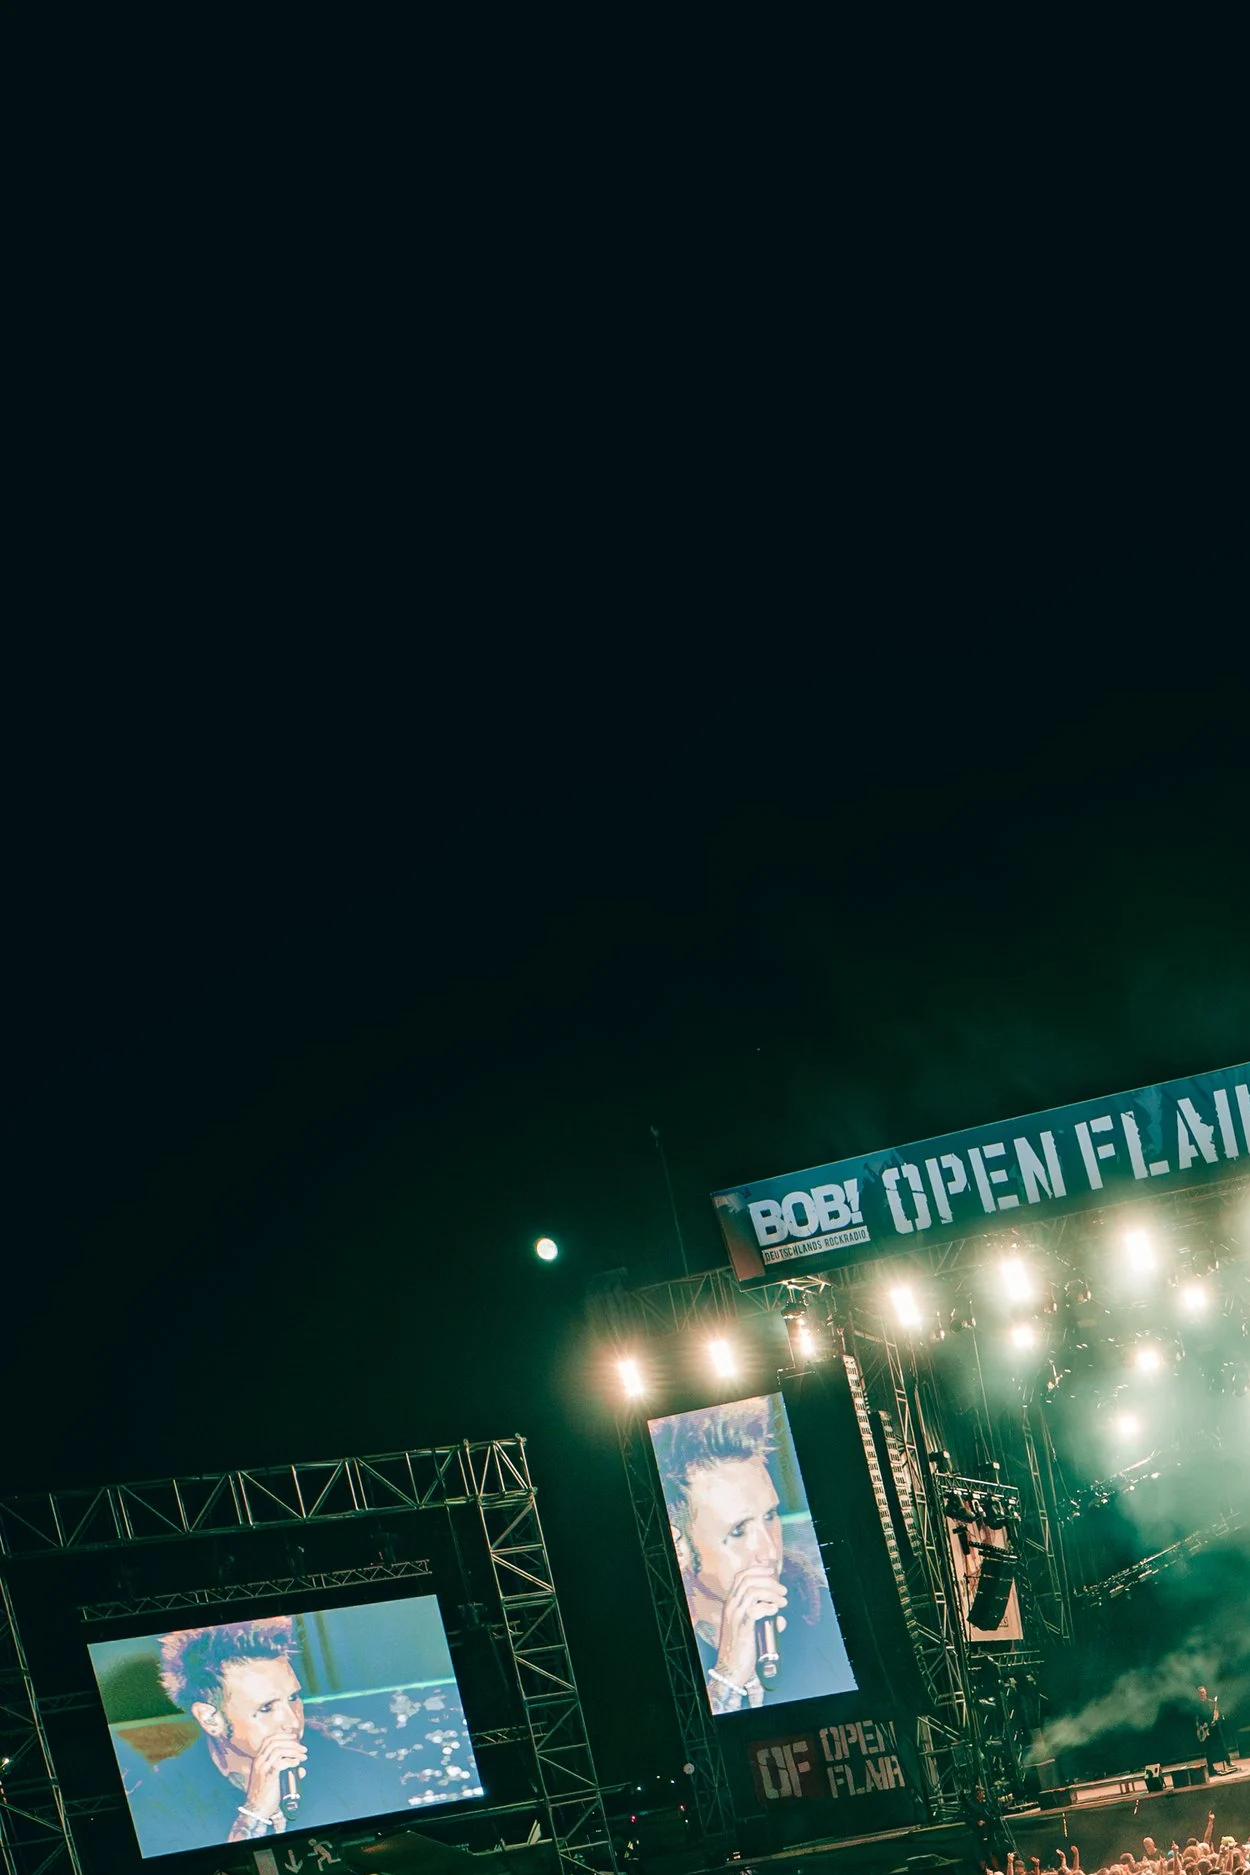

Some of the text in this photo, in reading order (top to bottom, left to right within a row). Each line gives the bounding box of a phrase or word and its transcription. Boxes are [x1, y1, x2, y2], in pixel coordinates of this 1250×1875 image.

[747, 1178, 864, 1247] BOB!
[884, 1131, 1066, 1234] OPEN
[764, 1229, 867, 1261] DEUTSCHLANDS ROCKRADIO
[756, 1740, 812, 1800] OF
[818, 1720, 899, 1762] OPEN
